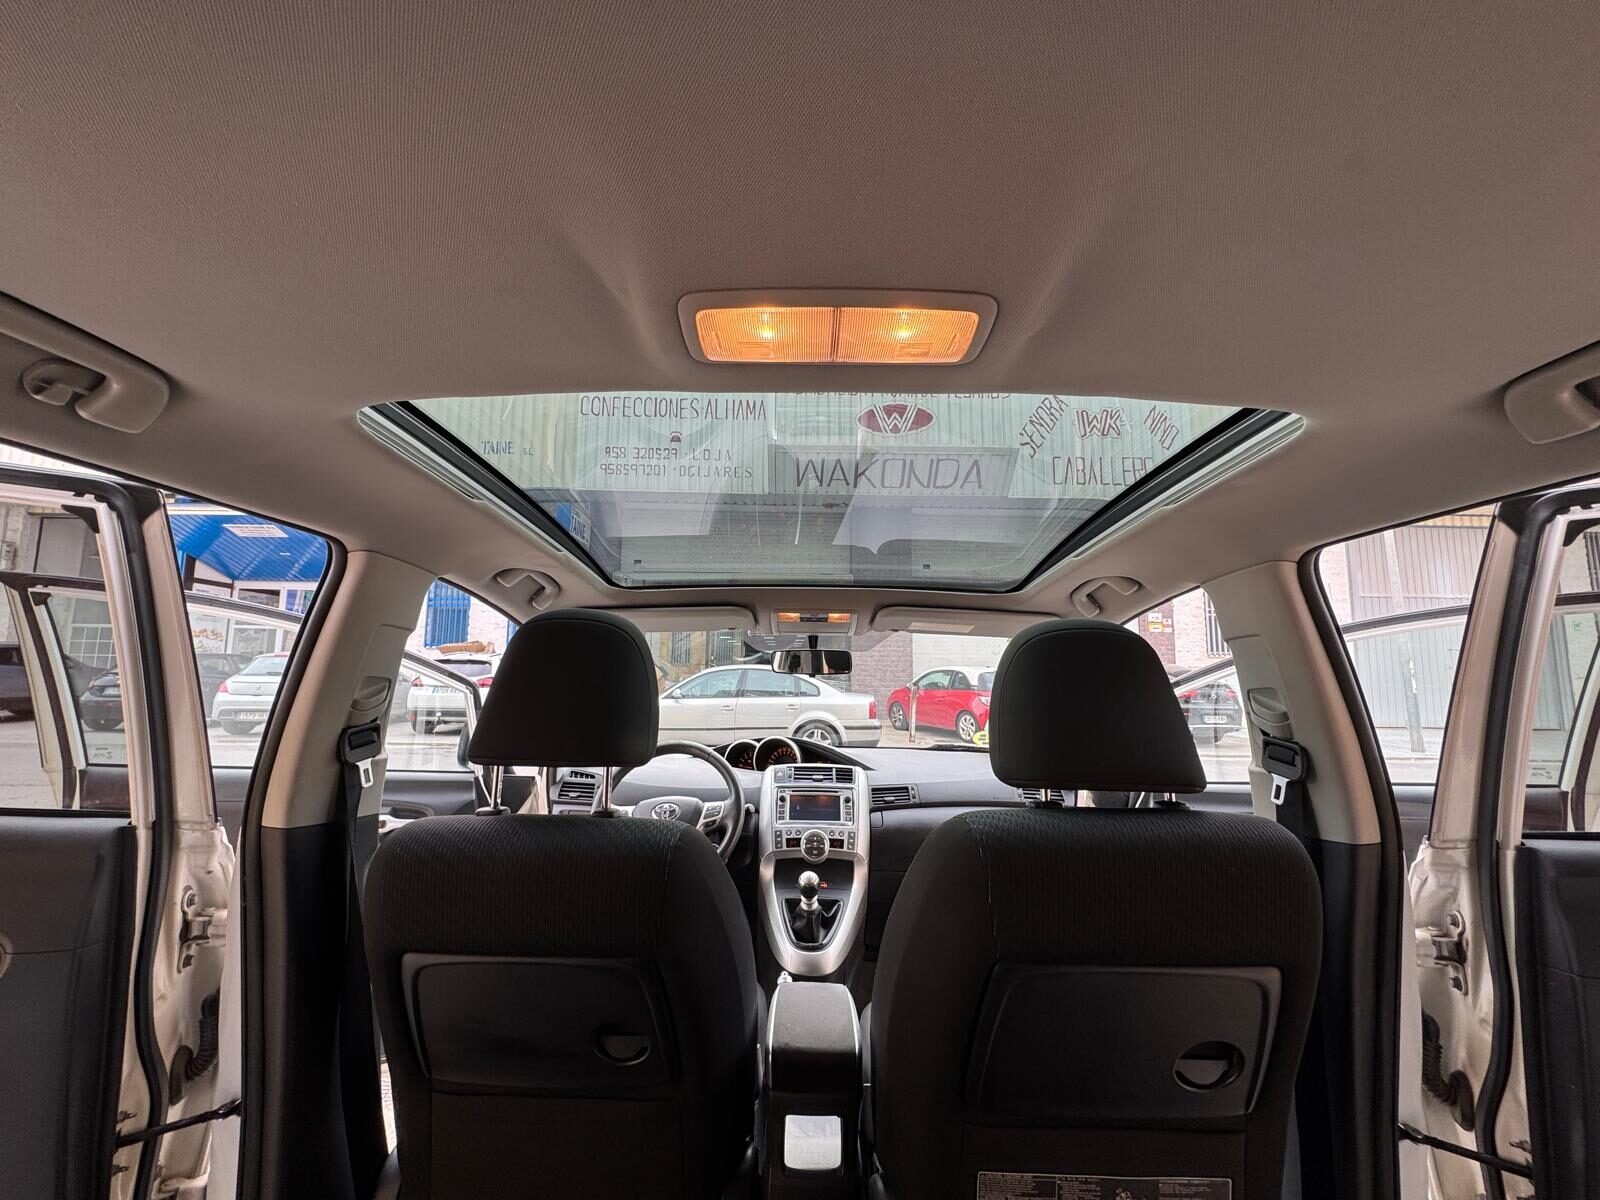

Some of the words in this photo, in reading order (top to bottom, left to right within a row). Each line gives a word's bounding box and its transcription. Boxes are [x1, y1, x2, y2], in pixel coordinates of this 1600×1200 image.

[580, 396, 700, 419] CONFECCIONES
[704, 398, 767, 421] ALHAMA
[481, 440, 513, 455] TAINE
[605, 446, 627, 459] 958
[632, 447, 679, 460] 320529
[692, 447, 732, 461] LOJA
[600, 463, 667, 477] 958597201
[679, 465, 752, 479] OGIJARES
[795, 457, 983, 490] WAKONDA
